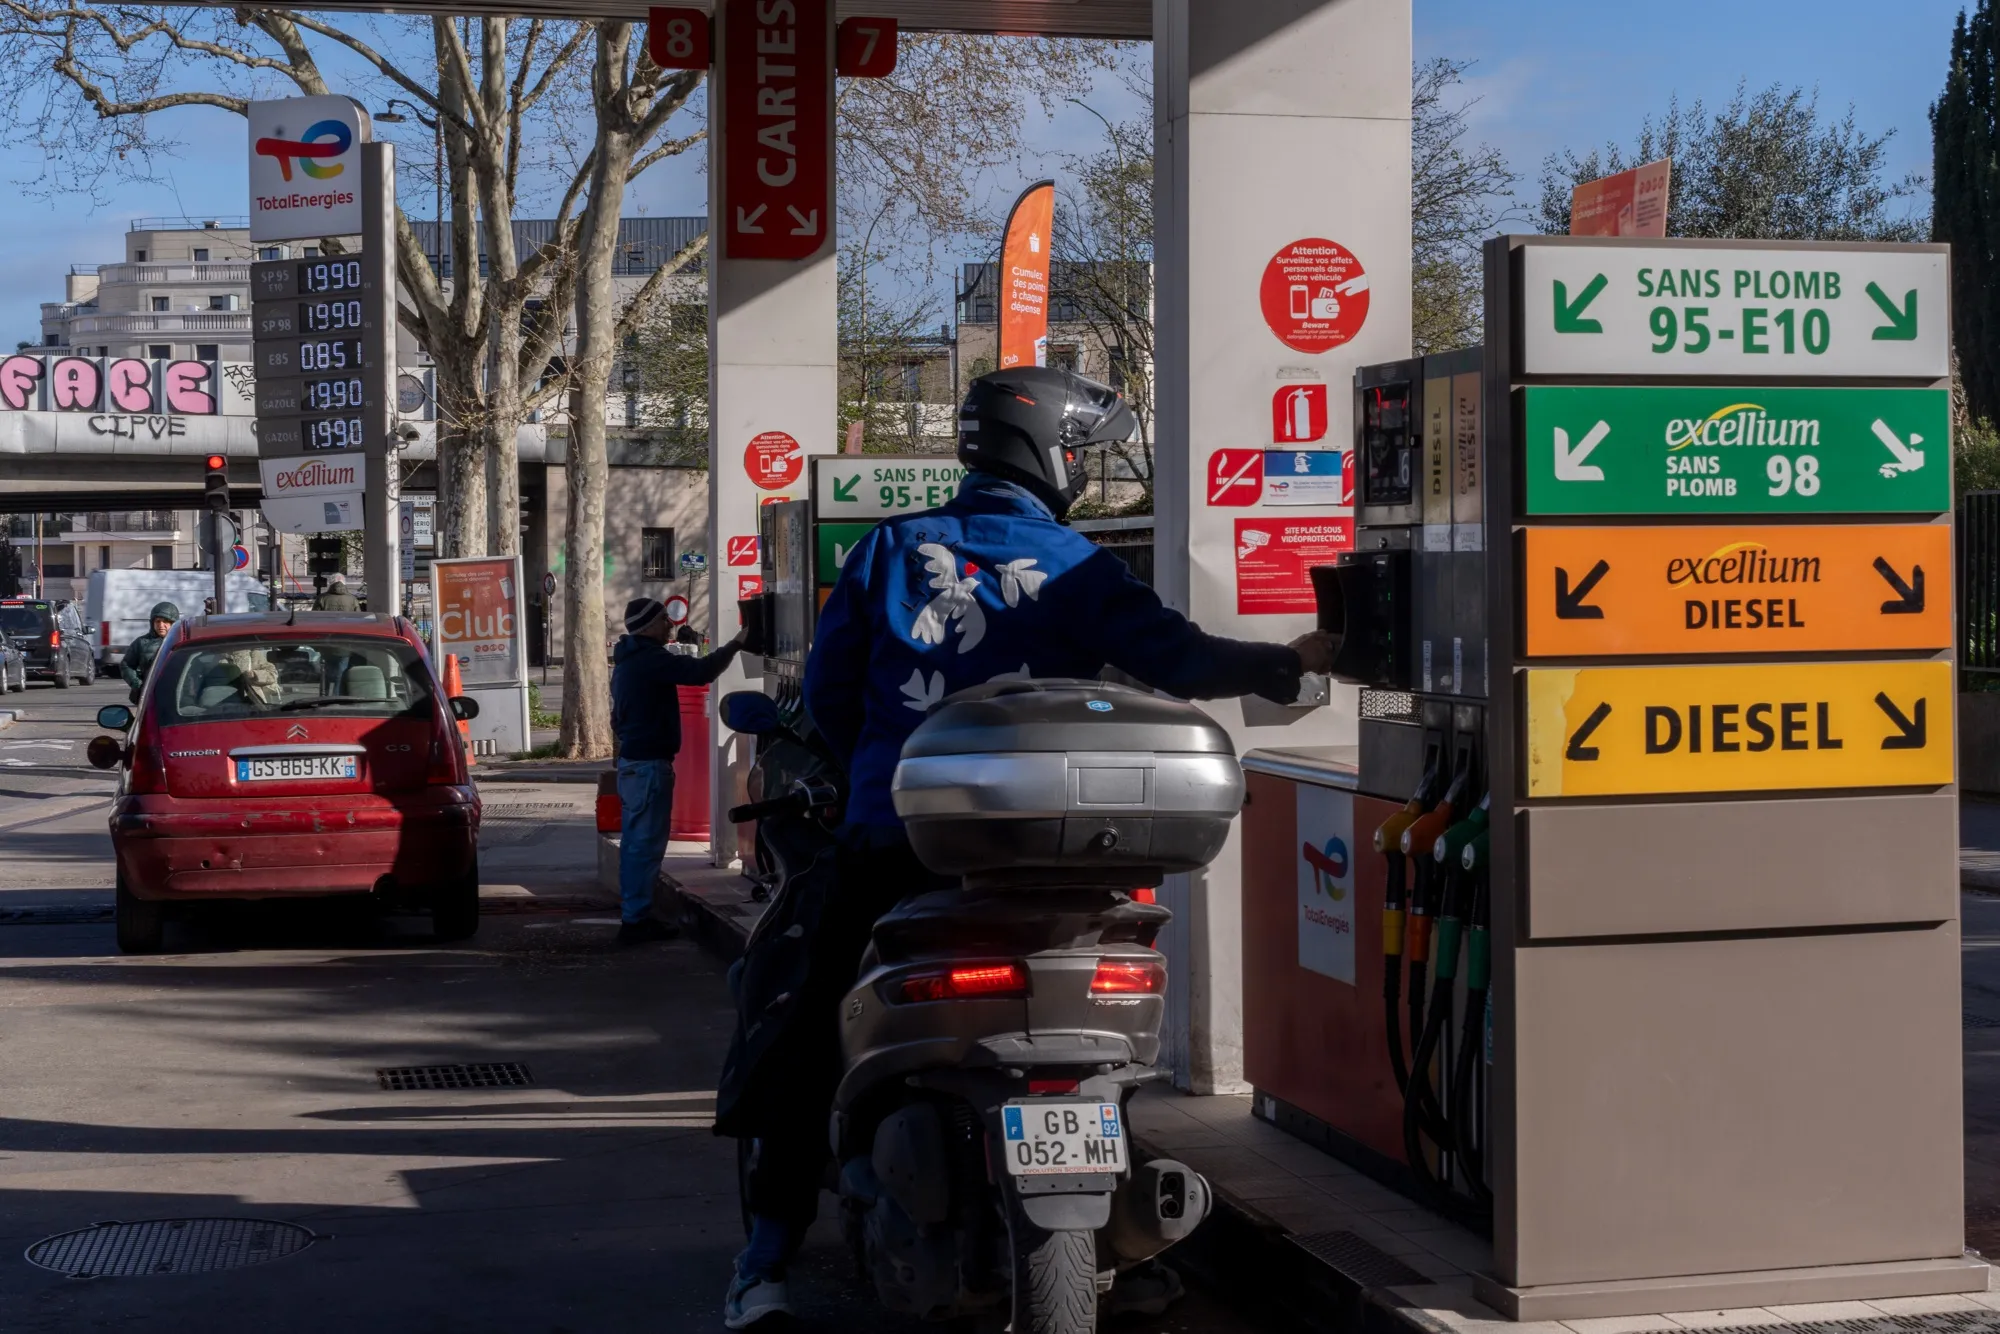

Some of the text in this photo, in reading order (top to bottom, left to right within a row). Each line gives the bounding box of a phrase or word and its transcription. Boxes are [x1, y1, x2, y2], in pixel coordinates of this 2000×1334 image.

[666, 18, 694, 58] 8
[856, 27, 880, 66] 7
[756, 0, 797, 187] CARTES
[256, 190, 354, 211] TotalEnergies
[1291, 247, 1338, 255] Attention
[1276, 257, 1314, 265] Surveillez
[261, 270, 289, 283] SP 95
[1012, 266, 1043, 281] Cumulez
[1283, 266, 1326, 274] personnels
[268, 283, 283, 292] E10
[1013, 278, 1027, 289] des
[1637, 268, 1841, 300] SANS PLOMB
[1012, 290, 1043, 304] à chaque
[1010, 302, 1041, 316] dépense
[262, 318, 291, 332] SP 98
[1649, 306, 1831, 355] 95-E10
[268, 353, 289, 365] E85
[1003, 353, 1019, 366] Club
[262, 399, 296, 410] GAZOLE
[1666, 409, 1821, 448] excellium
[264, 432, 299, 444] GAZOLE
[1467, 402, 1476, 488] DIESEL
[1433, 406, 1442, 495] DIESEL
[1458, 397, 1468, 495] excellium
[1400, 451, 1410, 485] 6
[1666, 455, 1720, 474] SANS
[276, 463, 355, 489] excellium
[873, 468, 916, 482] SANS
[1766, 454, 1821, 497] 98
[1666, 478, 1738, 497] PLOMB
[1300, 525, 1322, 534] PLACÉ
[1281, 534, 1346, 543] VIDÉOPROTECTION
[1666, 549, 1821, 586] excellium
[1685, 598, 1805, 630] DIESEL
[440, 605, 517, 641] Club
[1645, 701, 1843, 755] DIESEL
[169, 749, 221, 758] CITROËN
[386, 744, 411, 752] C3
[252, 757, 342, 777] GS-869-KK
[345, 766, 356, 776] 91
[1303, 904, 1350, 934] TotalEnergies
[1011, 1126, 1018, 1135] F
[1103, 1122, 1118, 1135] 92
